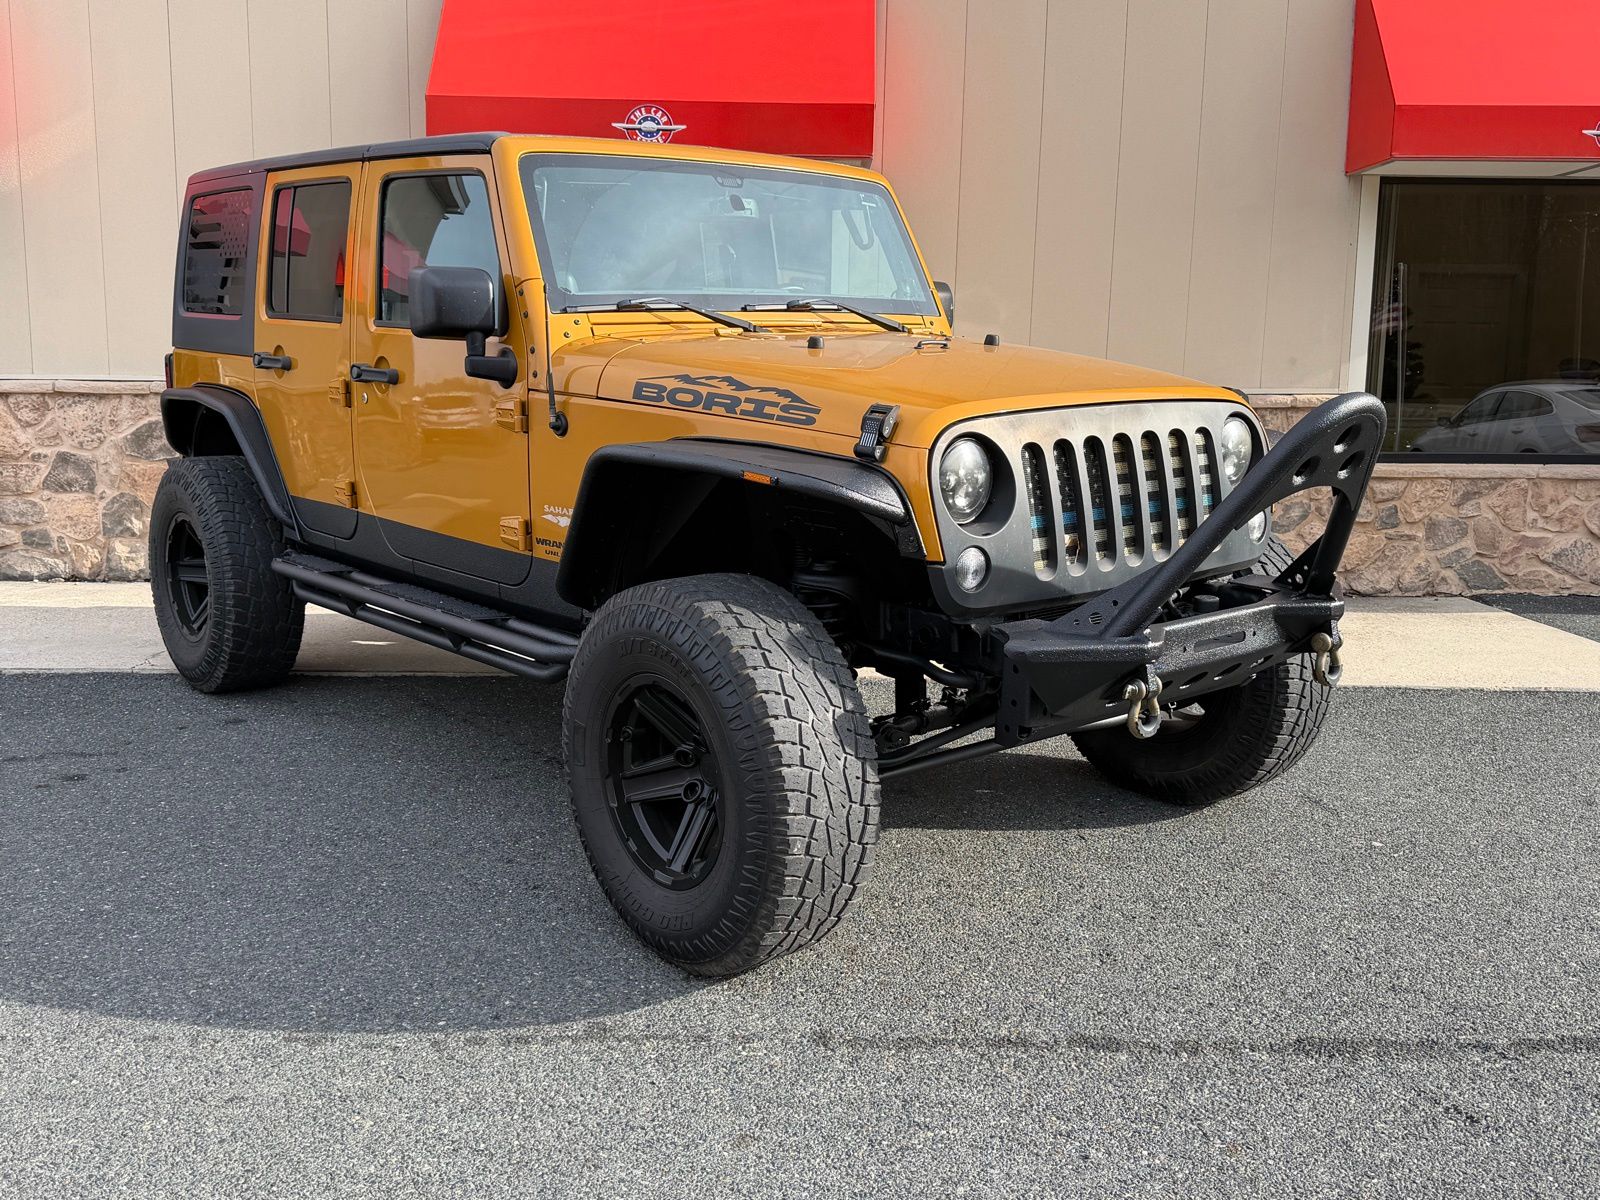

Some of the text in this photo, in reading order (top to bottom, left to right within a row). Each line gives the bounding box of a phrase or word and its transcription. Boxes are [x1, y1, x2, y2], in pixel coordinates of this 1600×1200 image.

[630, 107, 668, 123] THE CAR
[632, 381, 822, 426] BORIS
